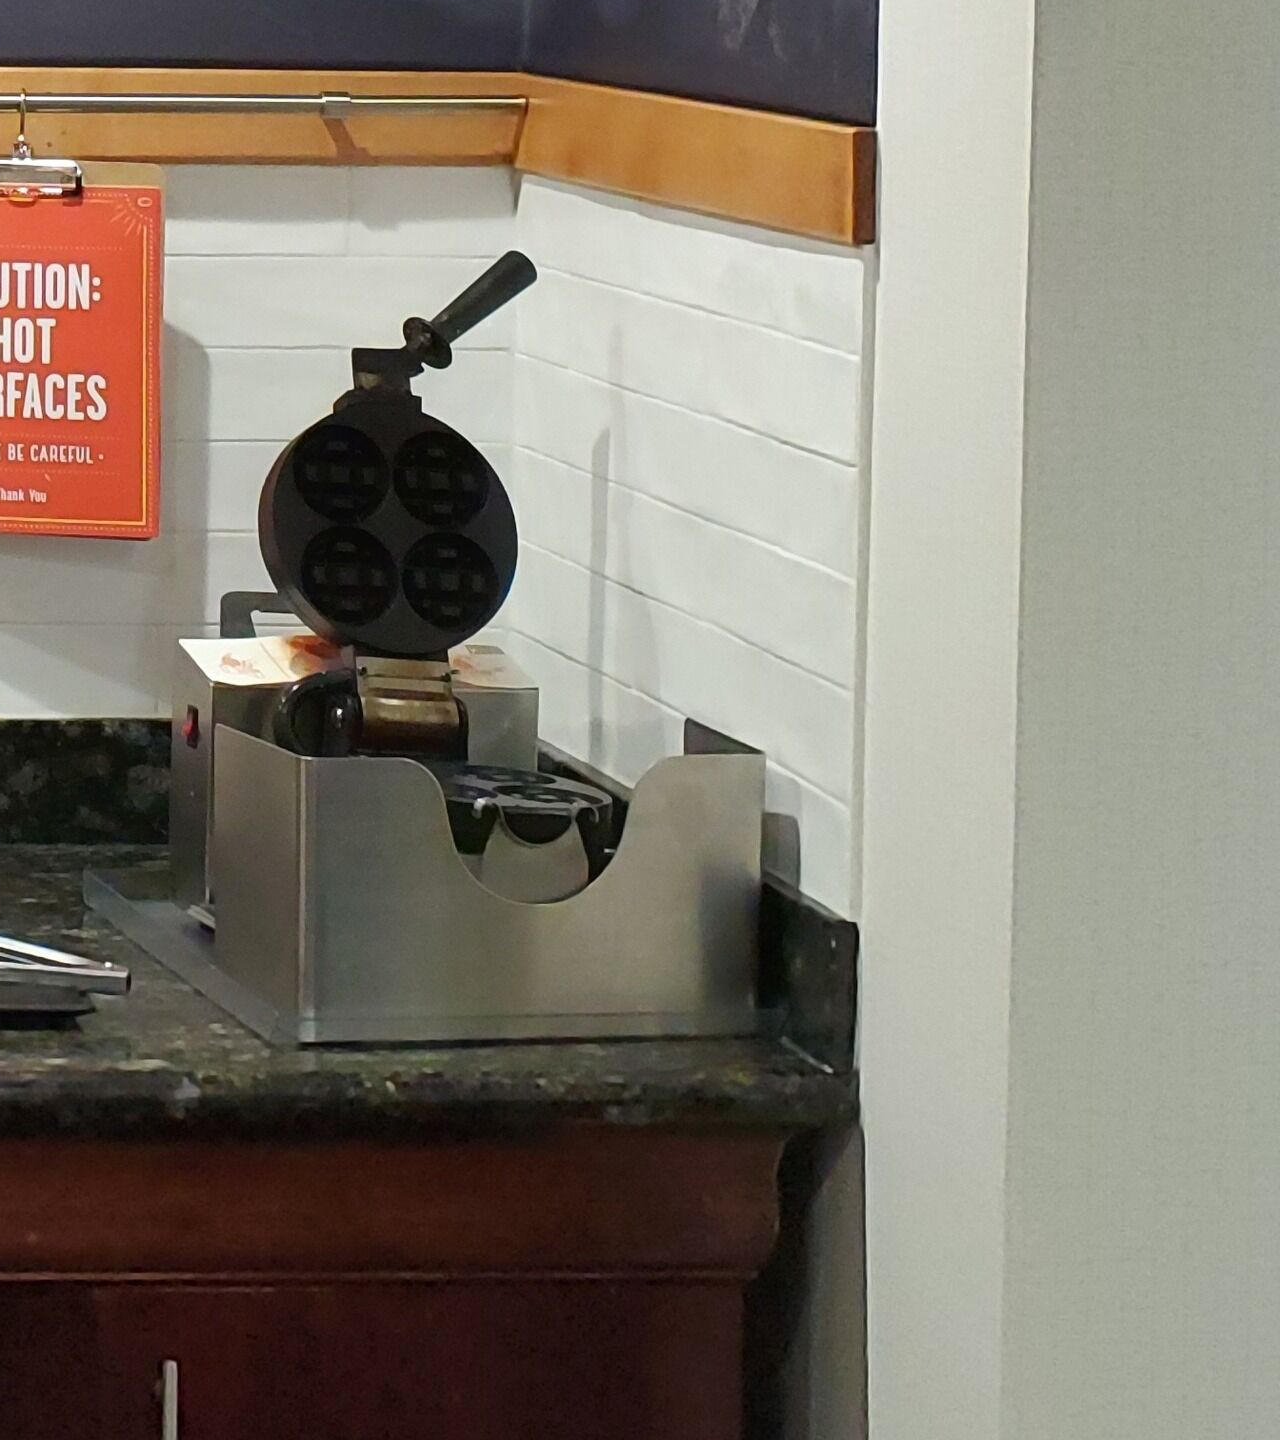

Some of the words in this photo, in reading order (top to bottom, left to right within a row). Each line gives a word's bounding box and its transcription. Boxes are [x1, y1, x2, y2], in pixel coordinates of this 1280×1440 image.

[8, 443, 24, 461] BE
[30, 444, 93, 464] CAREFUL
[29, 488, 47, 503] You
